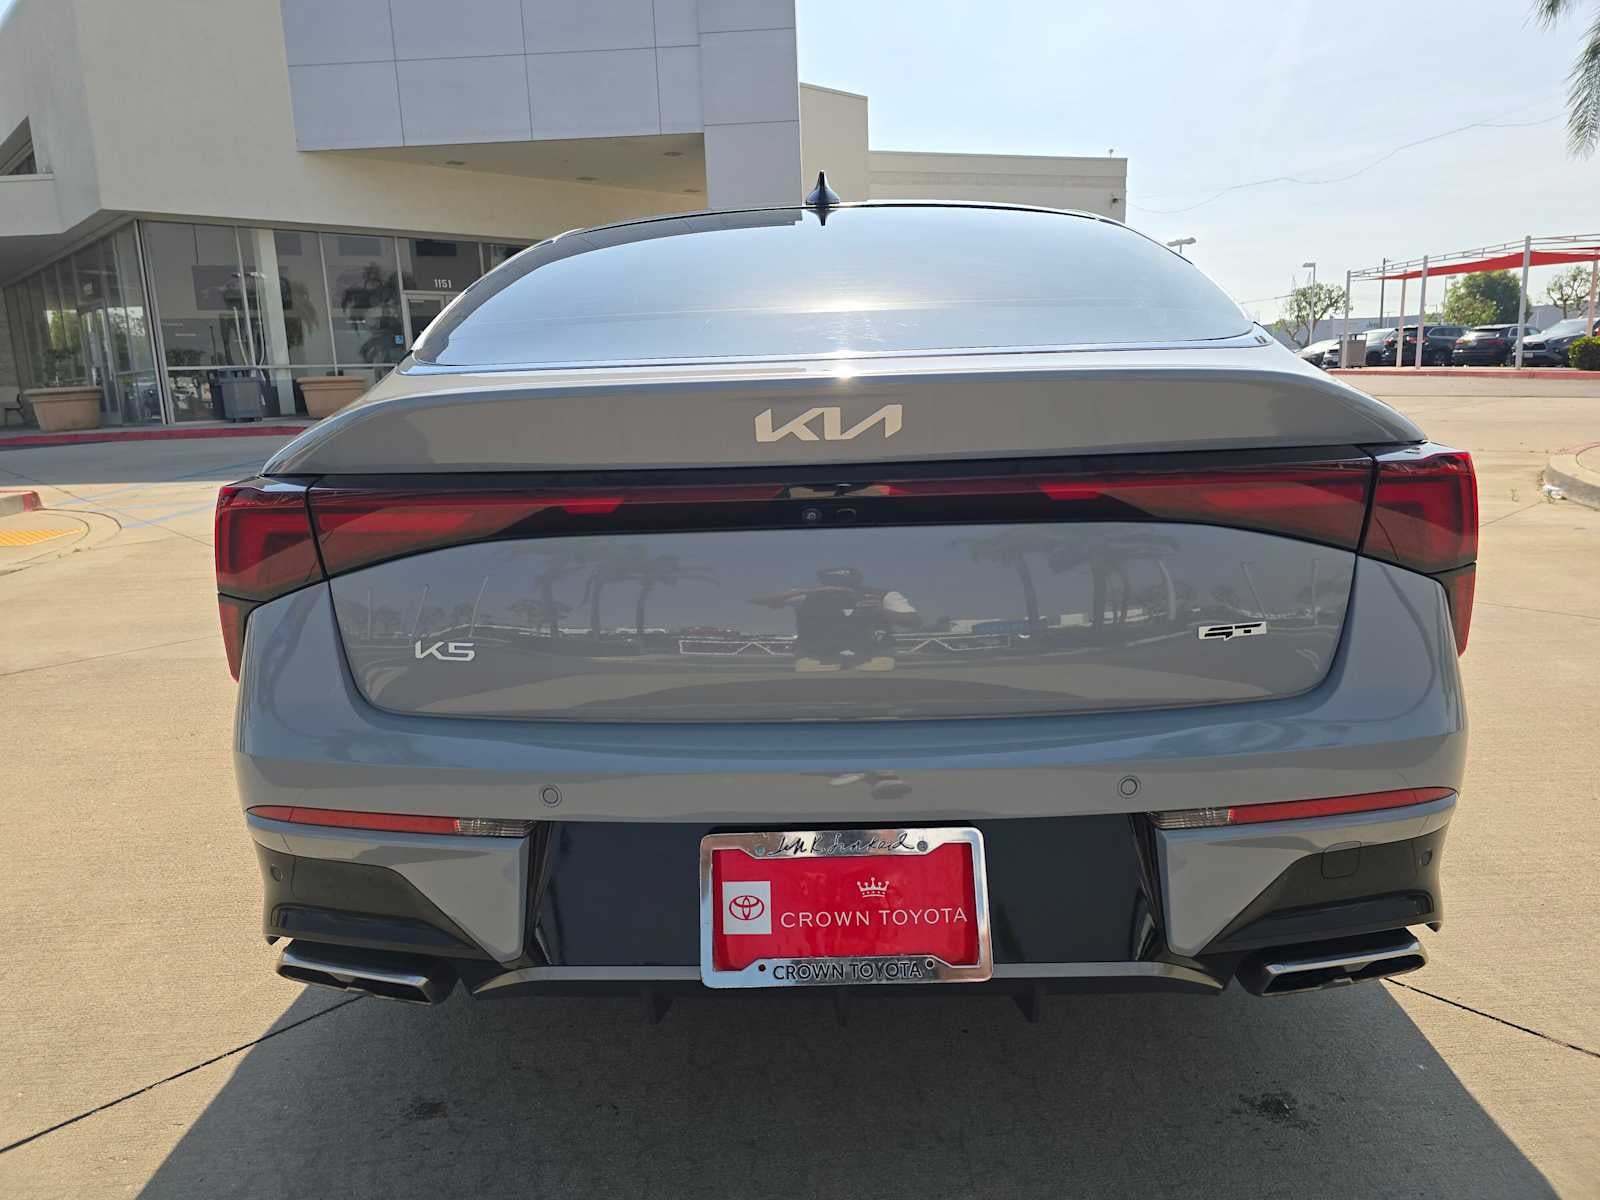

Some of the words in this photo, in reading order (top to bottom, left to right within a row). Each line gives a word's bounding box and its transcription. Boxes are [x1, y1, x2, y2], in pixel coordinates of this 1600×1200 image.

[434, 278, 452, 289] 1151
[415, 640, 475, 661] K5
[780, 910, 870, 929] CROWN
[879, 906, 968, 926] TOYOTA
[773, 963, 844, 981] CROWN
[851, 959, 923, 979] TOYOTA
